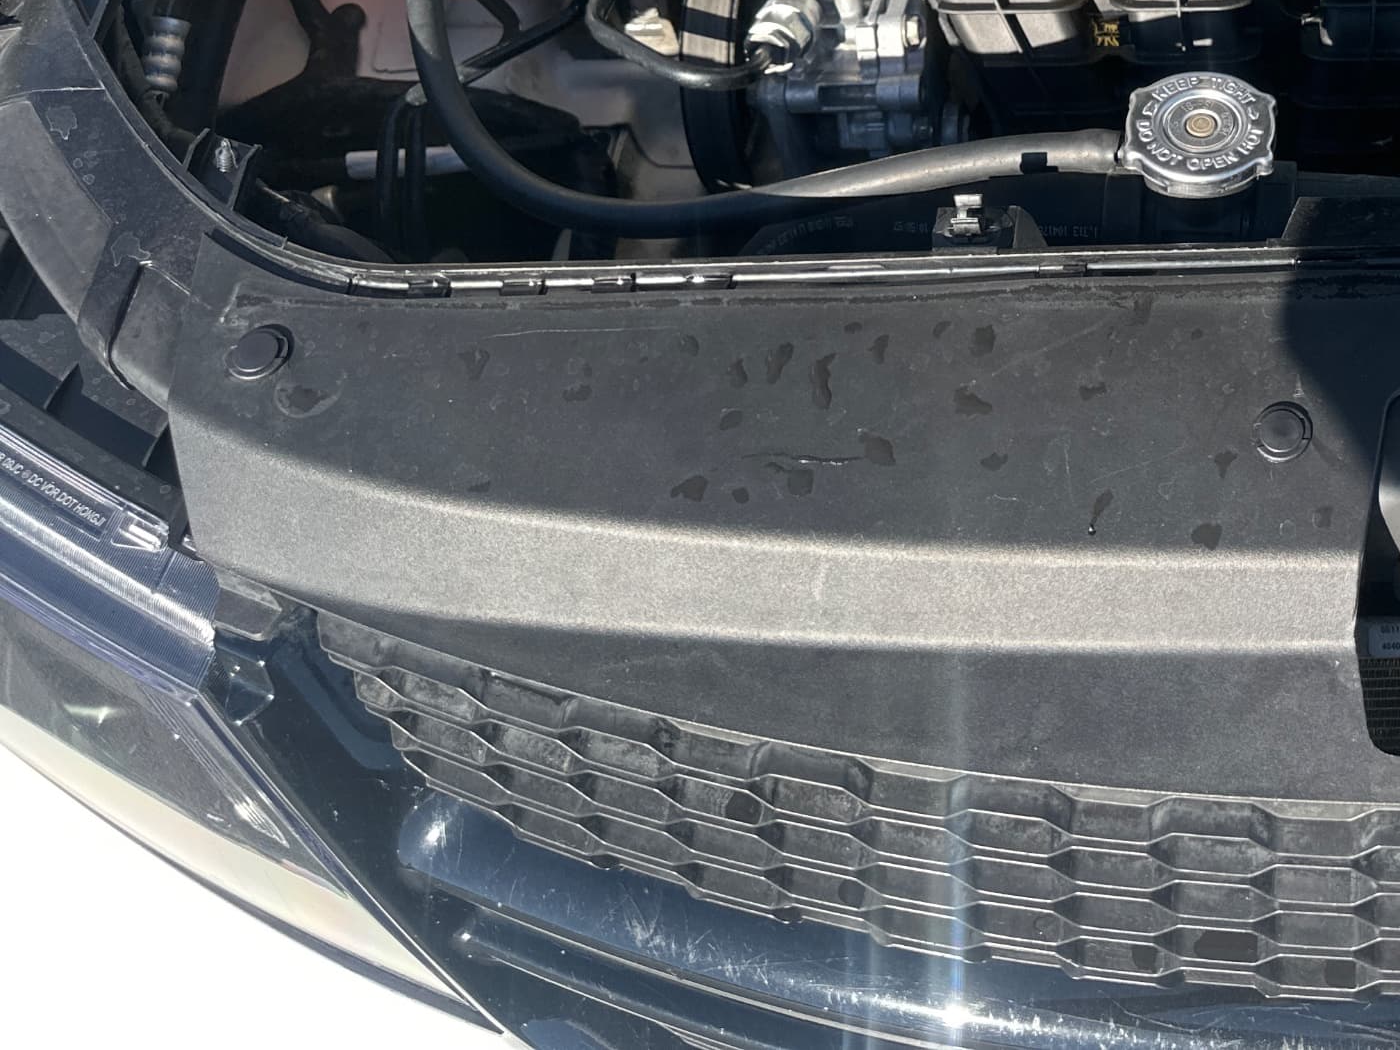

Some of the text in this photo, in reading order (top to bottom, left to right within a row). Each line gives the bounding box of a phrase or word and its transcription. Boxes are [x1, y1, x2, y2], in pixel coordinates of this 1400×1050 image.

[1151, 76, 1257, 104] KEEP TIGHT
[1136, 119, 1264, 171] DO NOT OPEN HOT
[56, 492, 79, 509] DOT
